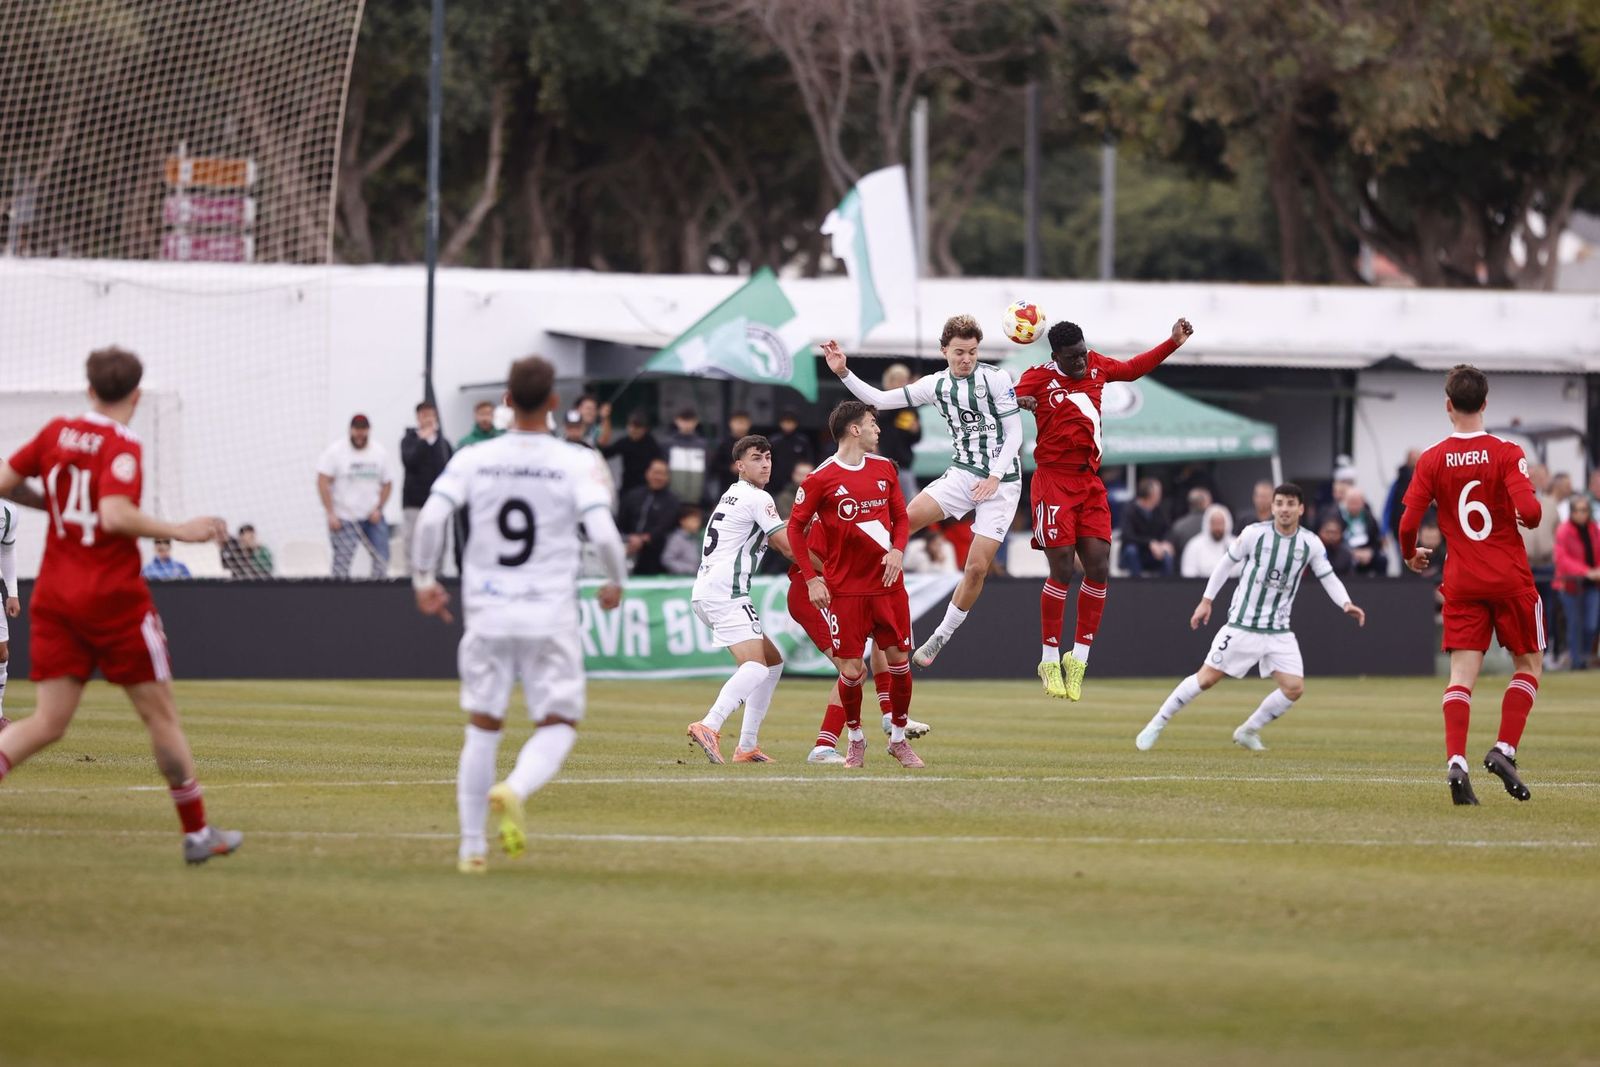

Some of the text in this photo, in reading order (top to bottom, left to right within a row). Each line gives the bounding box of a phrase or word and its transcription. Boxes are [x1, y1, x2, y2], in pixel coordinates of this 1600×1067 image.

[1446, 449, 1490, 468] RIVERA
[46, 462, 99, 547] 14
[1047, 505, 1060, 525] 17
[1458, 480, 1493, 541] 6
[497, 497, 536, 567] 9
[830, 614, 840, 636] 8
[1218, 635, 1233, 651] 3
